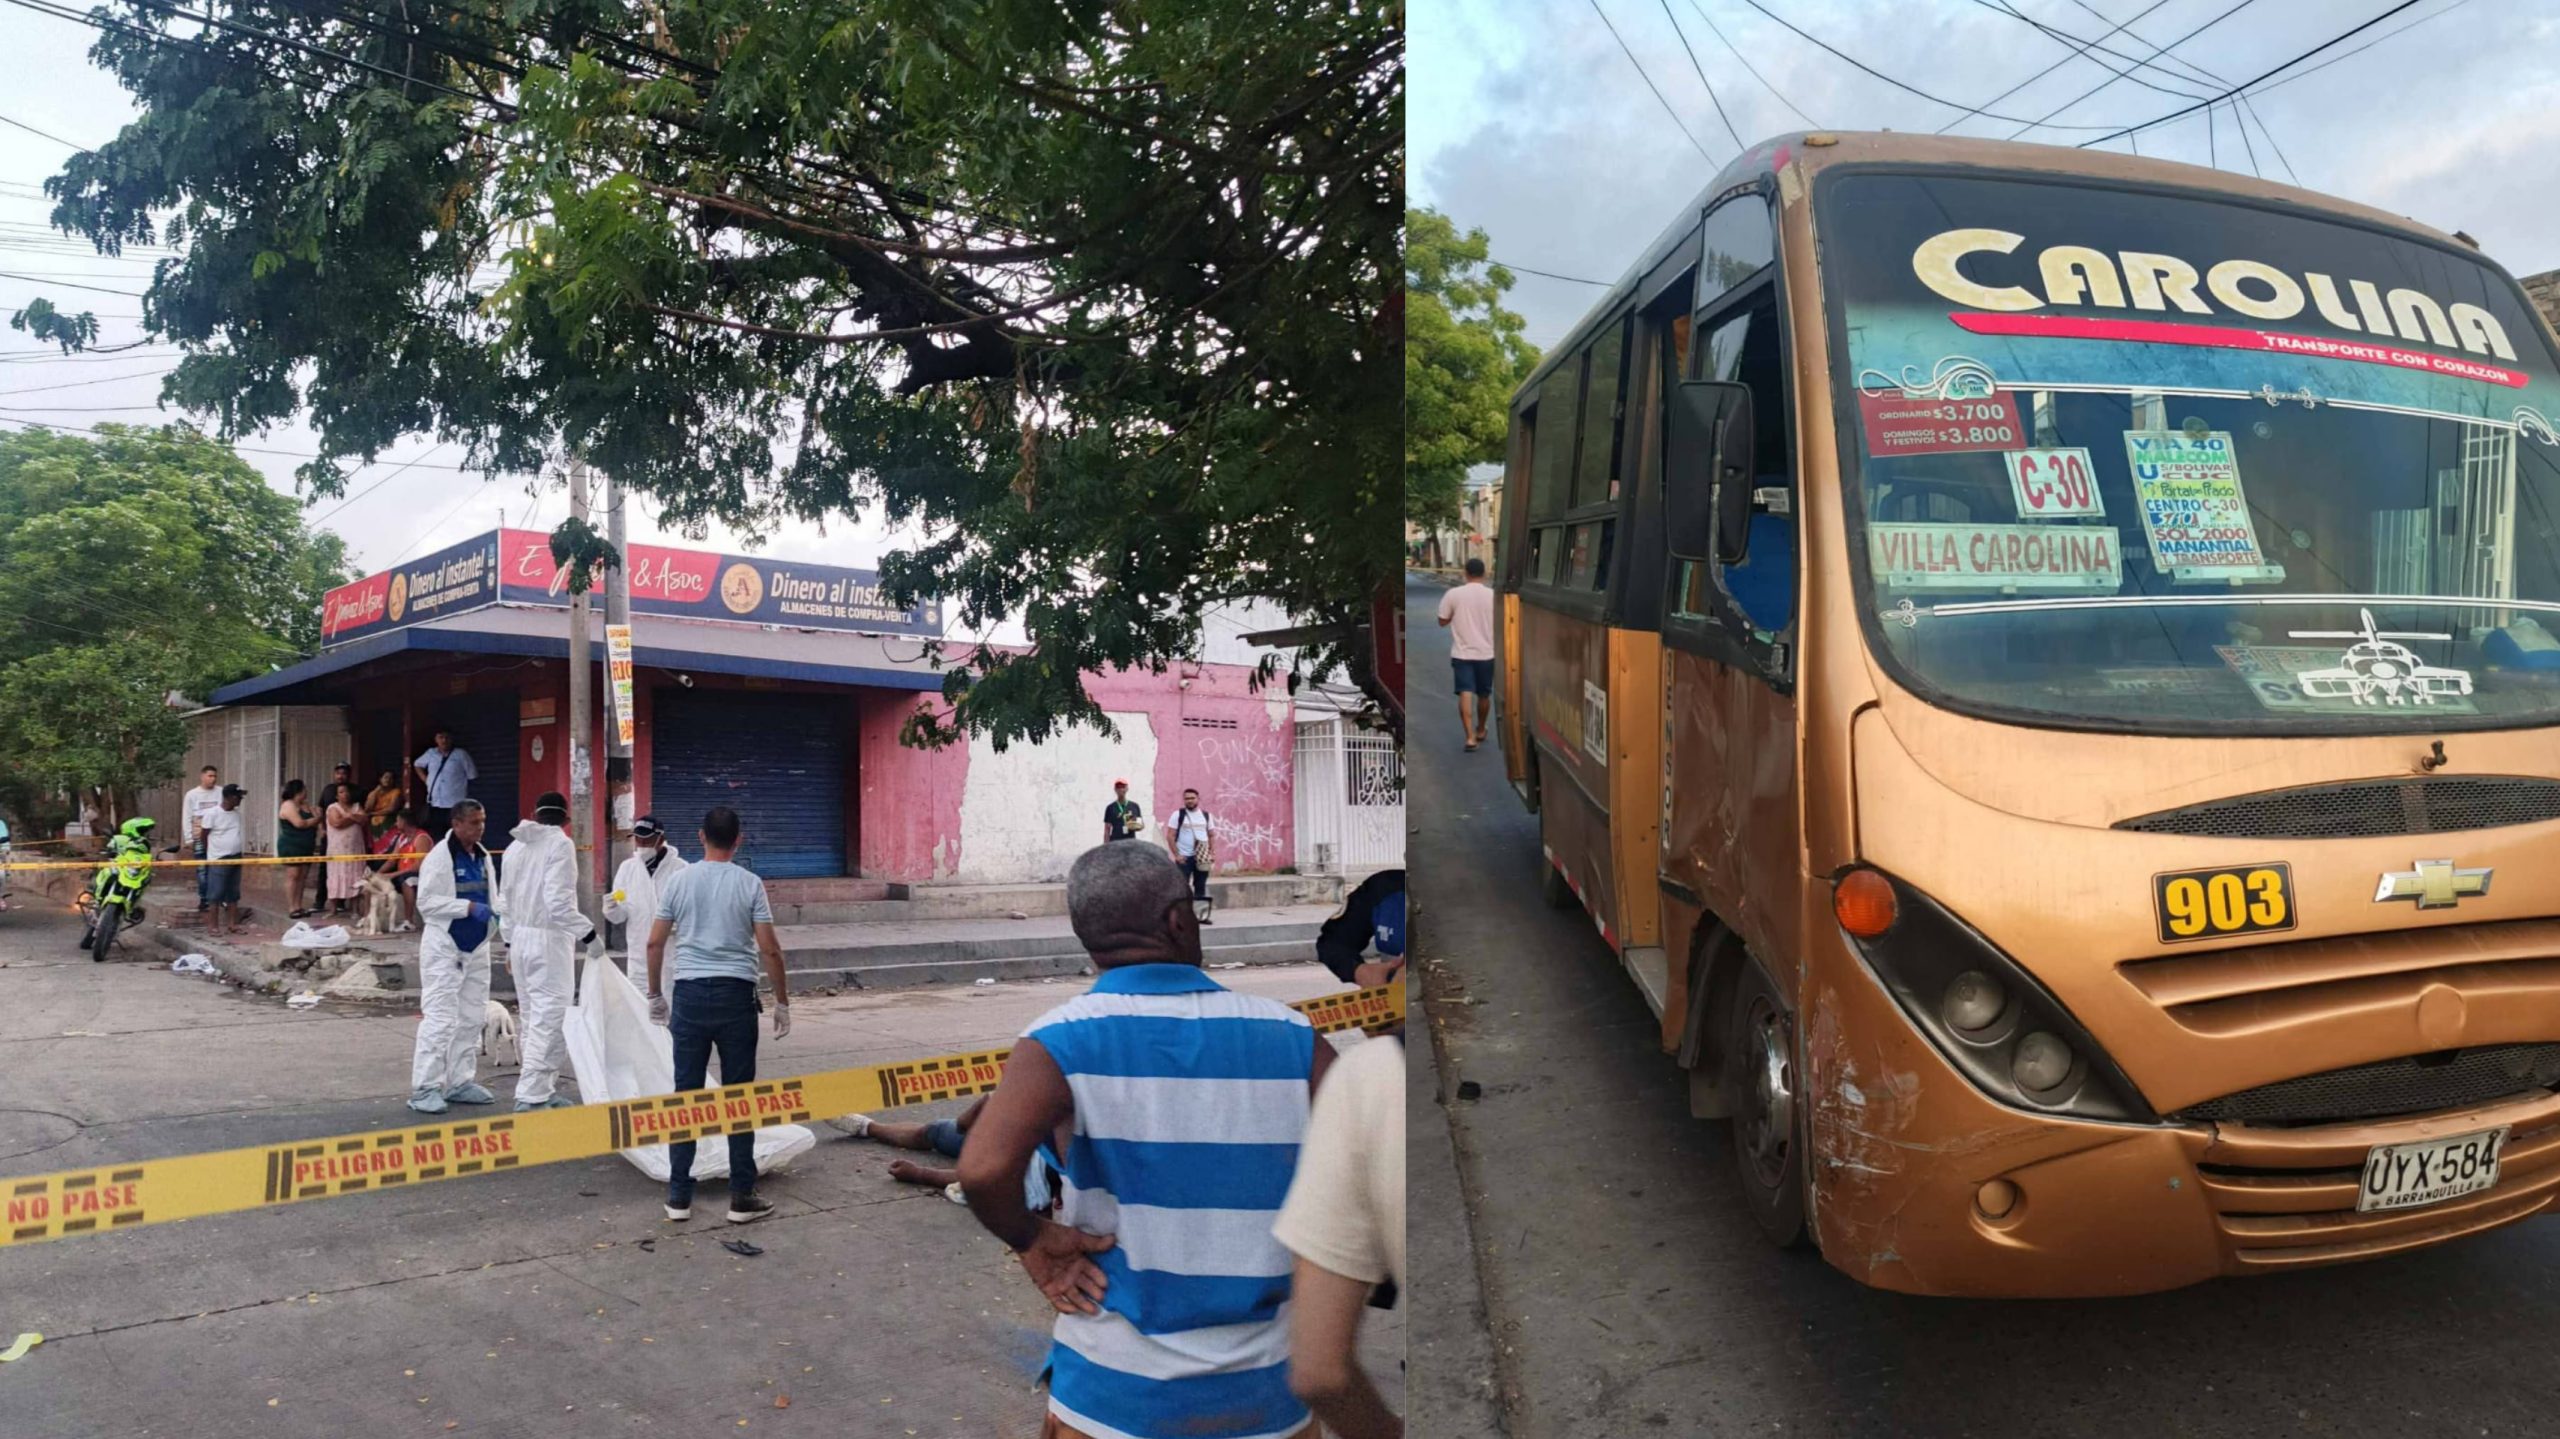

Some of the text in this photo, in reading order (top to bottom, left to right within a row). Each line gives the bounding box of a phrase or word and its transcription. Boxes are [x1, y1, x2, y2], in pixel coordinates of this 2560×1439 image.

[1912, 227, 2518, 362] CAROLINA
[2264, 336, 2510, 382] TRANSPORTE CON CORAZON
[1879, 404, 2005, 421] ORDINARIO $3.700
[1883, 426, 2012, 444] DOMINGOS $3.800
[1884, 437, 1936, 446] Y FESTIVOS
[2191, 438, 2224, 451] 40
[2019, 454, 2090, 509] C-30
[2146, 499, 2201, 512] CENTRO
[2155, 528, 2248, 541] SOL 2000
[2158, 540, 2254, 553] MANANTIAL
[1878, 531, 2112, 574] VILLA CAROLINA
[2174, 552, 2259, 564] TRANSPORTE
[409, 548, 486, 599] Dinero al instante!
[634, 558, 652, 588] &
[770, 572, 826, 601] Dinero
[830, 577, 847, 605] al
[780, 601, 913, 624] ALMACENES DE COMPRA-VENTA
[1198, 733, 1261, 775] PUNK
[2165, 869, 2286, 936] 903
[1343, 1002, 1361, 1018] NO
[1362, 997, 1390, 1014] PASE
[898, 1068, 969, 1095] PELIGRO
[972, 1064, 996, 1082] NO
[632, 1090, 805, 1134] PELIGRO NO PASE
[294, 1131, 514, 1184] PELIGRO NO PASE
[7, 1184, 138, 1224] NO PASE
[2385, 1181, 2473, 1206] BARRANQUILLA
